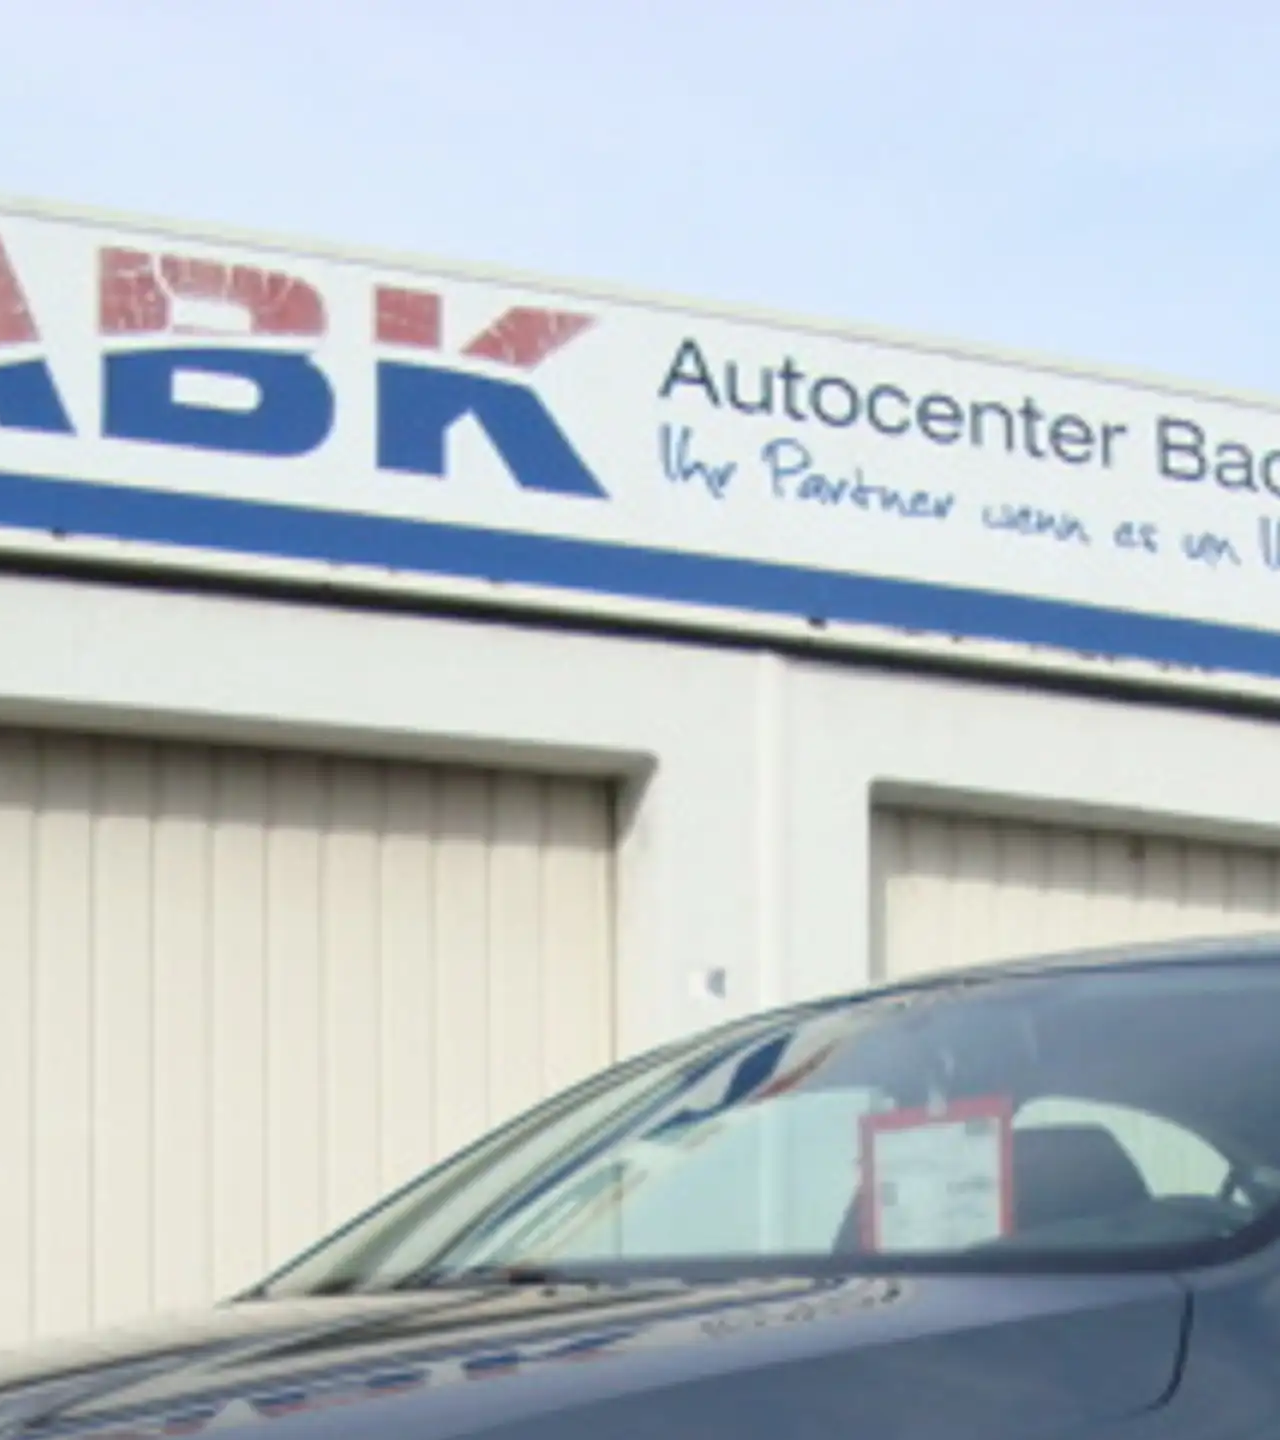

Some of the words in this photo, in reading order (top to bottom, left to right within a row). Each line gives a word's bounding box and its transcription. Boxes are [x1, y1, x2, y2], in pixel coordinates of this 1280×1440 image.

[657, 336, 1128, 469] Autocenter
[659, 421, 739, 501] Ihr
[760, 436, 956, 520] Partner
[981, 502, 1093, 547] wenn
[1113, 519, 1160, 554] es
